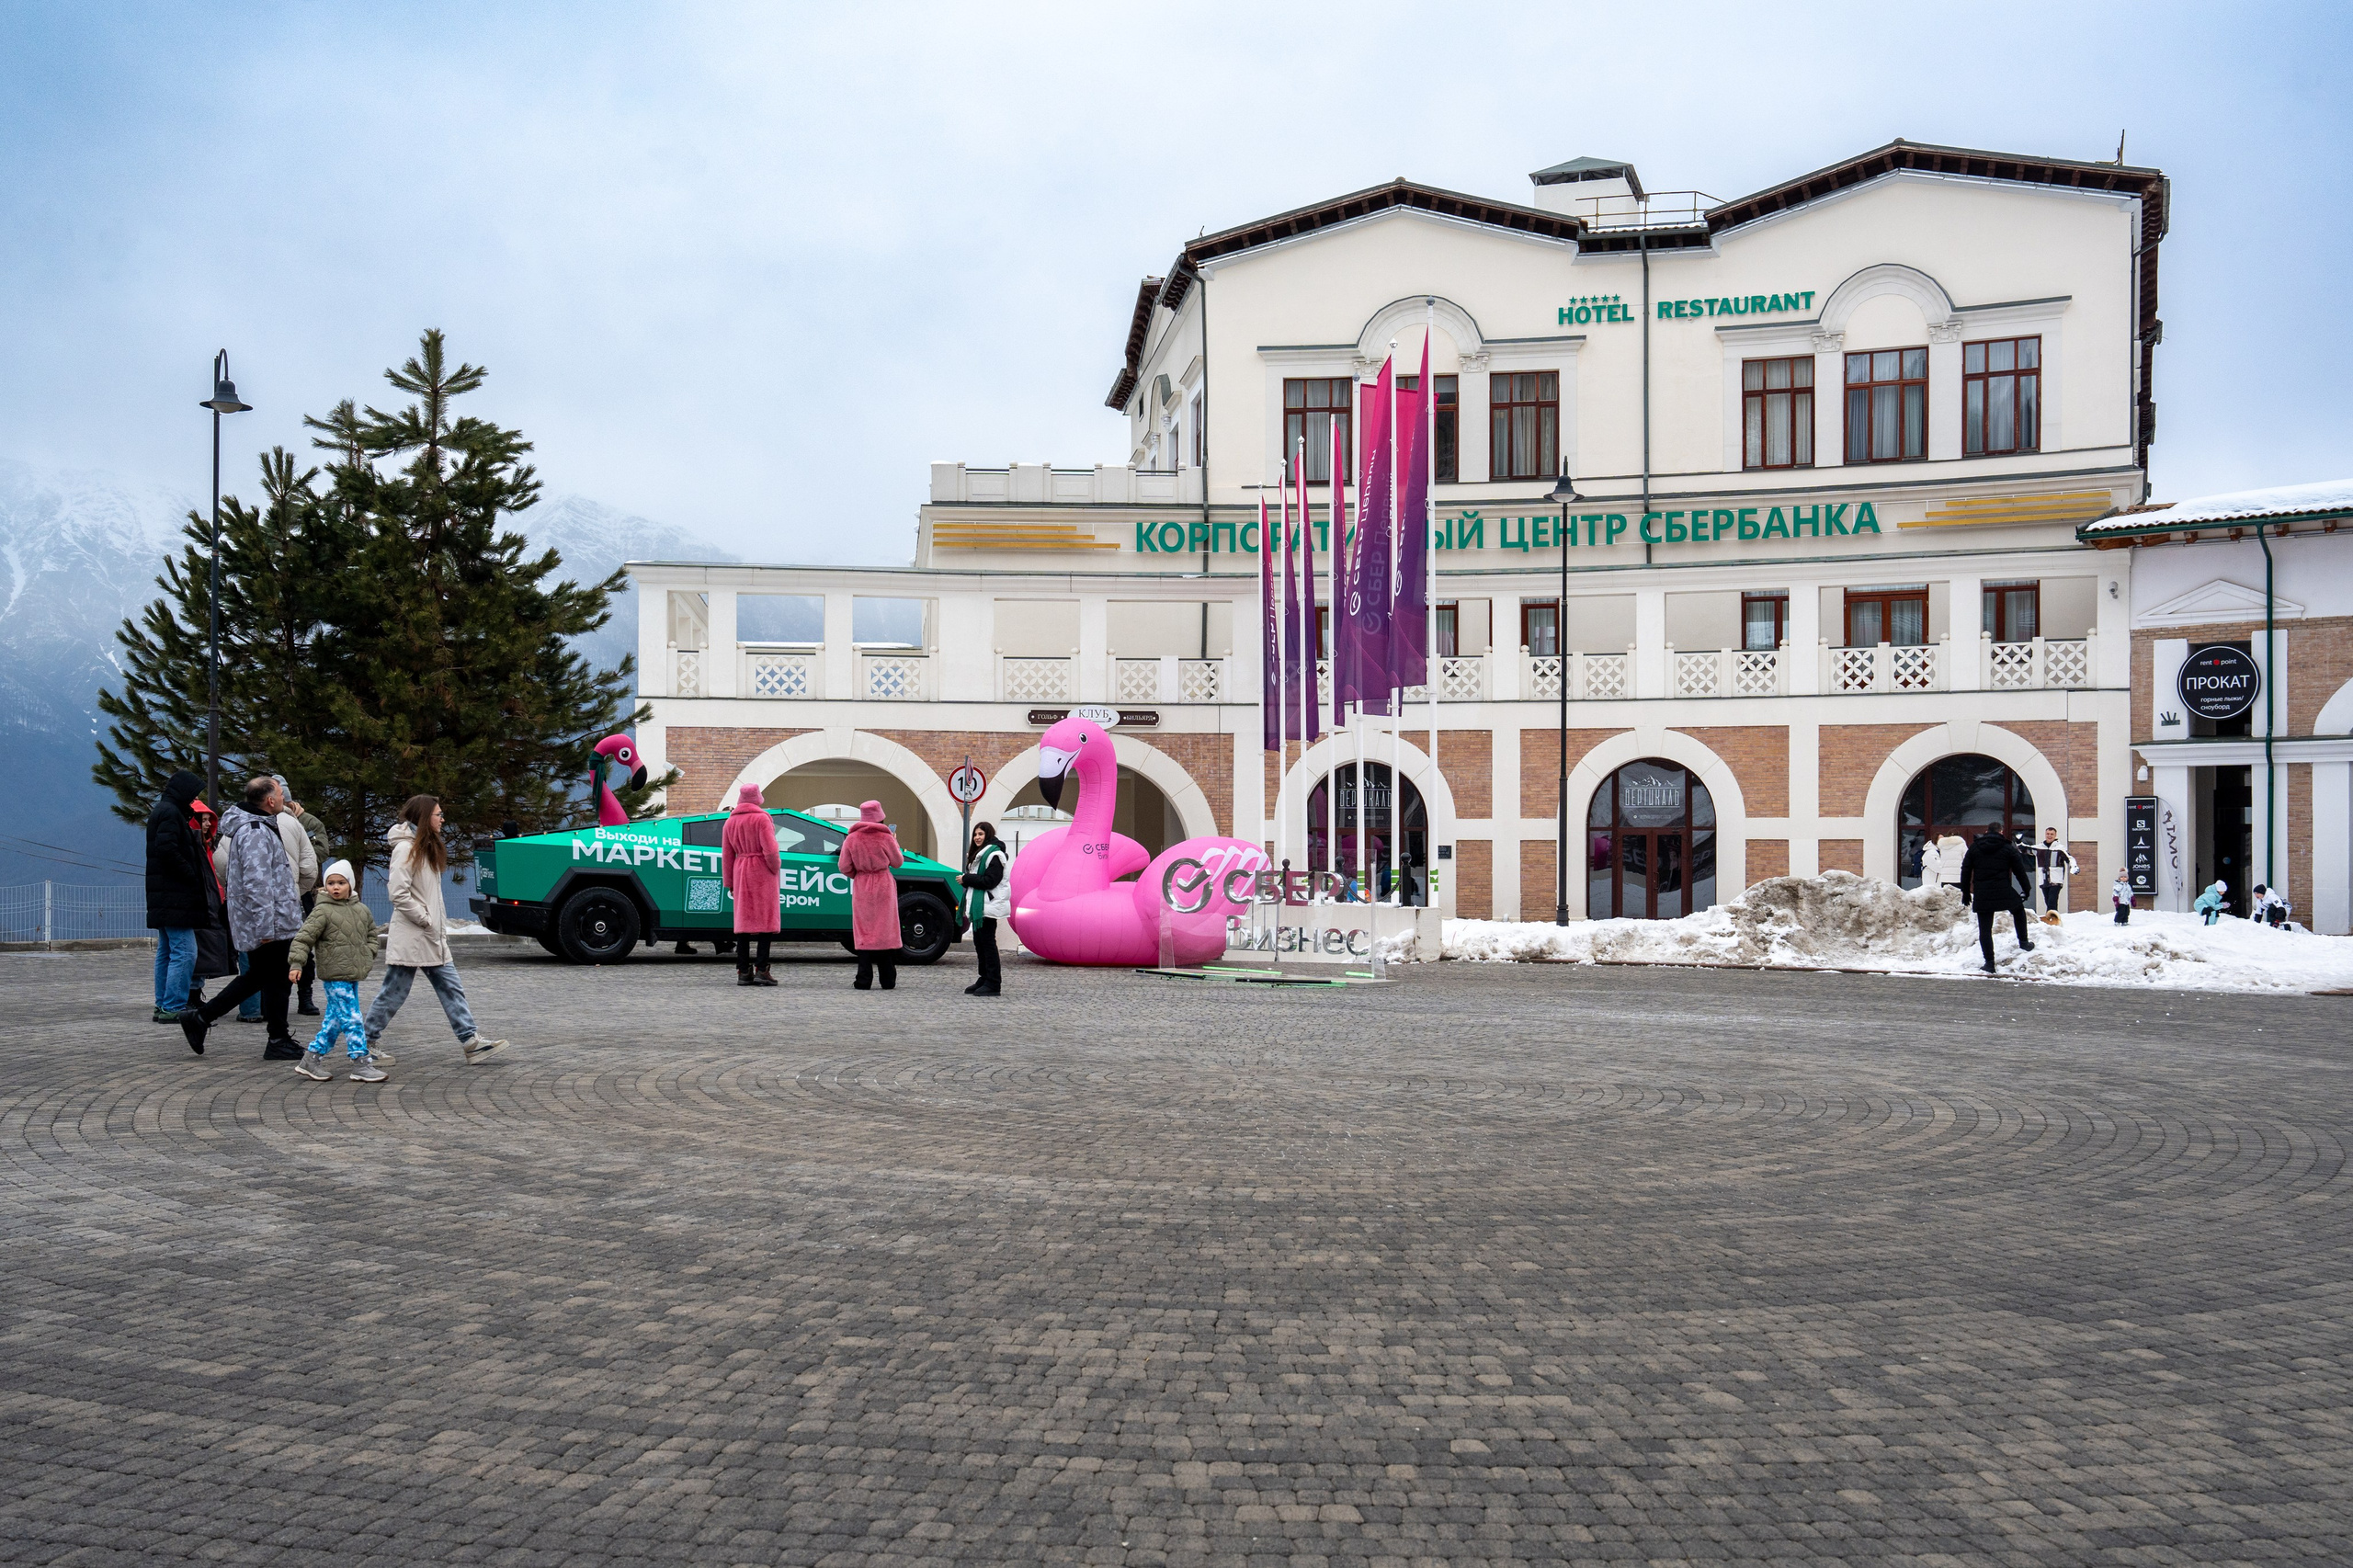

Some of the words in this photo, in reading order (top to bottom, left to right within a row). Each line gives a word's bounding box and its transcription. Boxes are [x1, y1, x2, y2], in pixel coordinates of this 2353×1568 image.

[1558, 303, 1634, 324] HOTEL
[1657, 291, 1815, 319] RESTAURANT
[1500, 514, 1627, 552] ЦЕНТР
[1639, 502, 1881, 544] СБЕРБАНКА
[2187, 675, 2250, 690] ПРОКАТ
[1078, 709, 1109, 719] КЛУБ
[1624, 789, 1680, 806] ВЕРТИКАЛЬ
[595, 828, 658, 846] Выходи
[662, 837, 681, 846] на
[572, 838, 854, 895] МАРКЕТЕЙС
[1223, 869, 1345, 908] СБЕР
[1225, 915, 1370, 956] Бизнес
